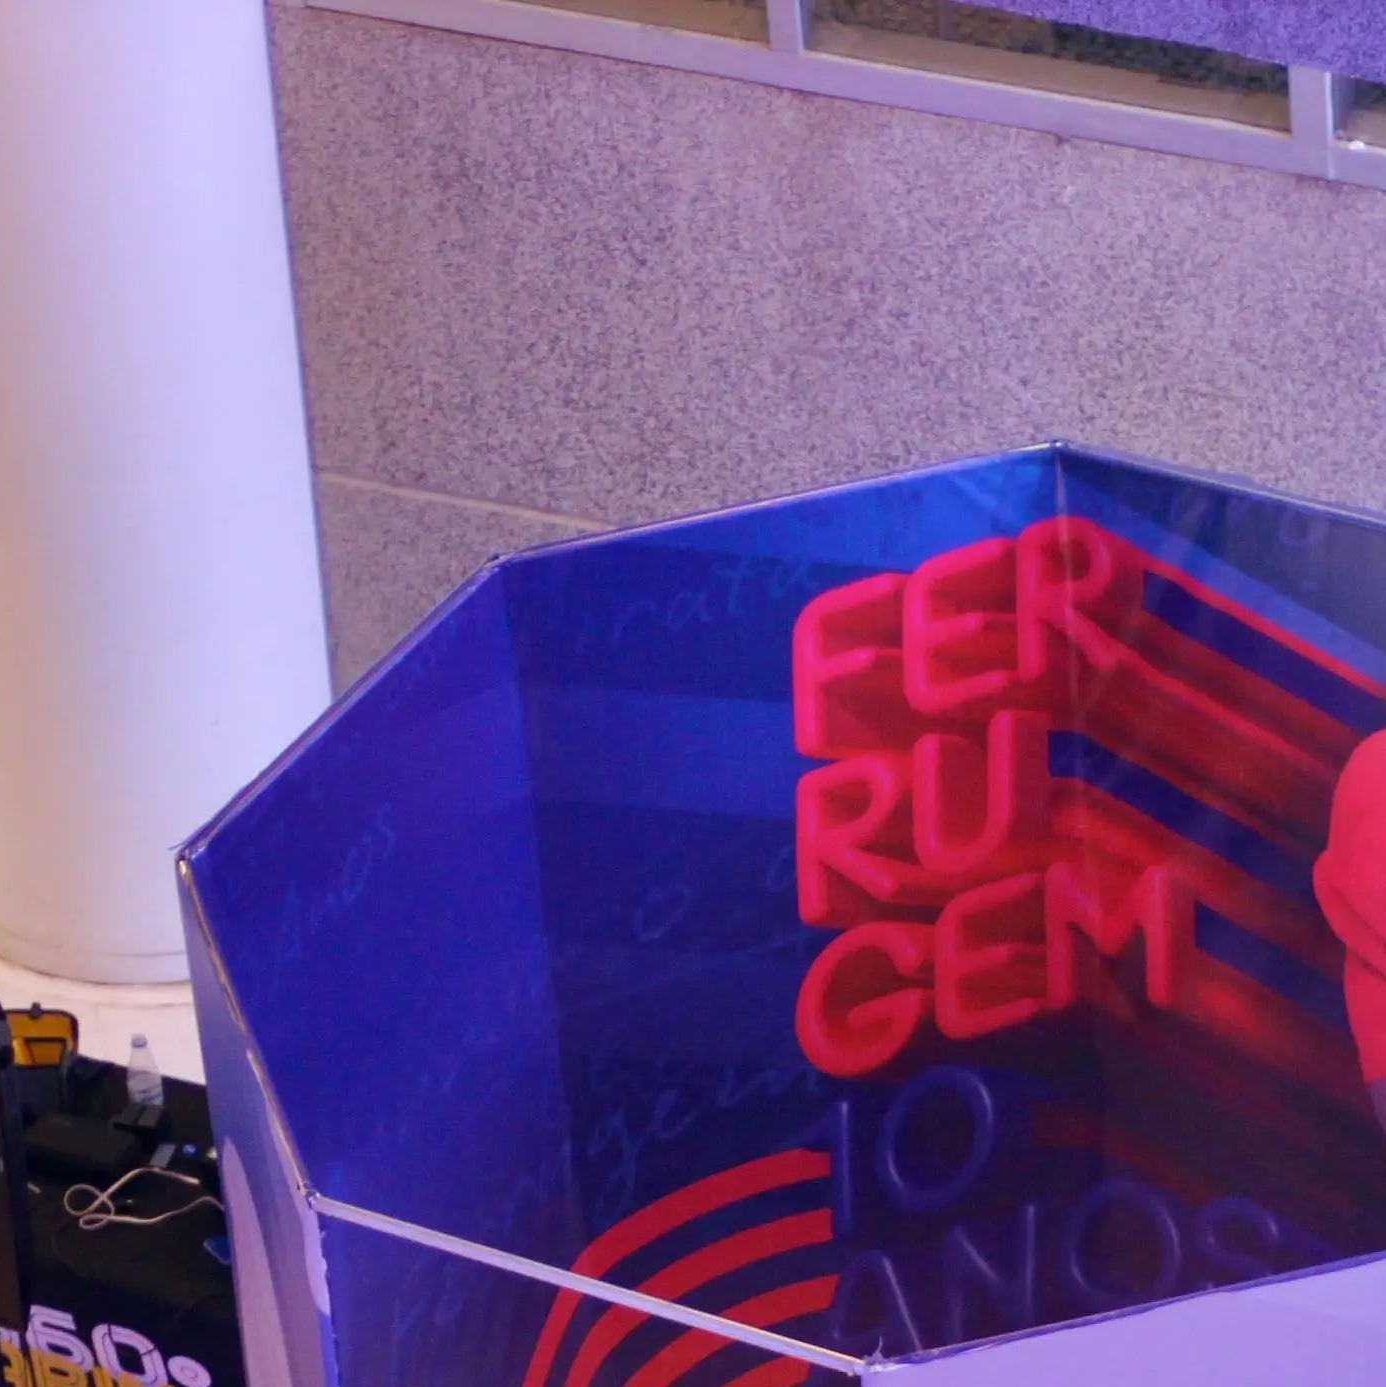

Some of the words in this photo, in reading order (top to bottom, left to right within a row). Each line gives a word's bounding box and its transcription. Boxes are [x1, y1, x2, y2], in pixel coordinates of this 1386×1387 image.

[792, 515, 1114, 759] FER
[795, 709, 1014, 926] RU
[795, 860, 1176, 1078] GEM
[779, 1064, 996, 1239] 10
